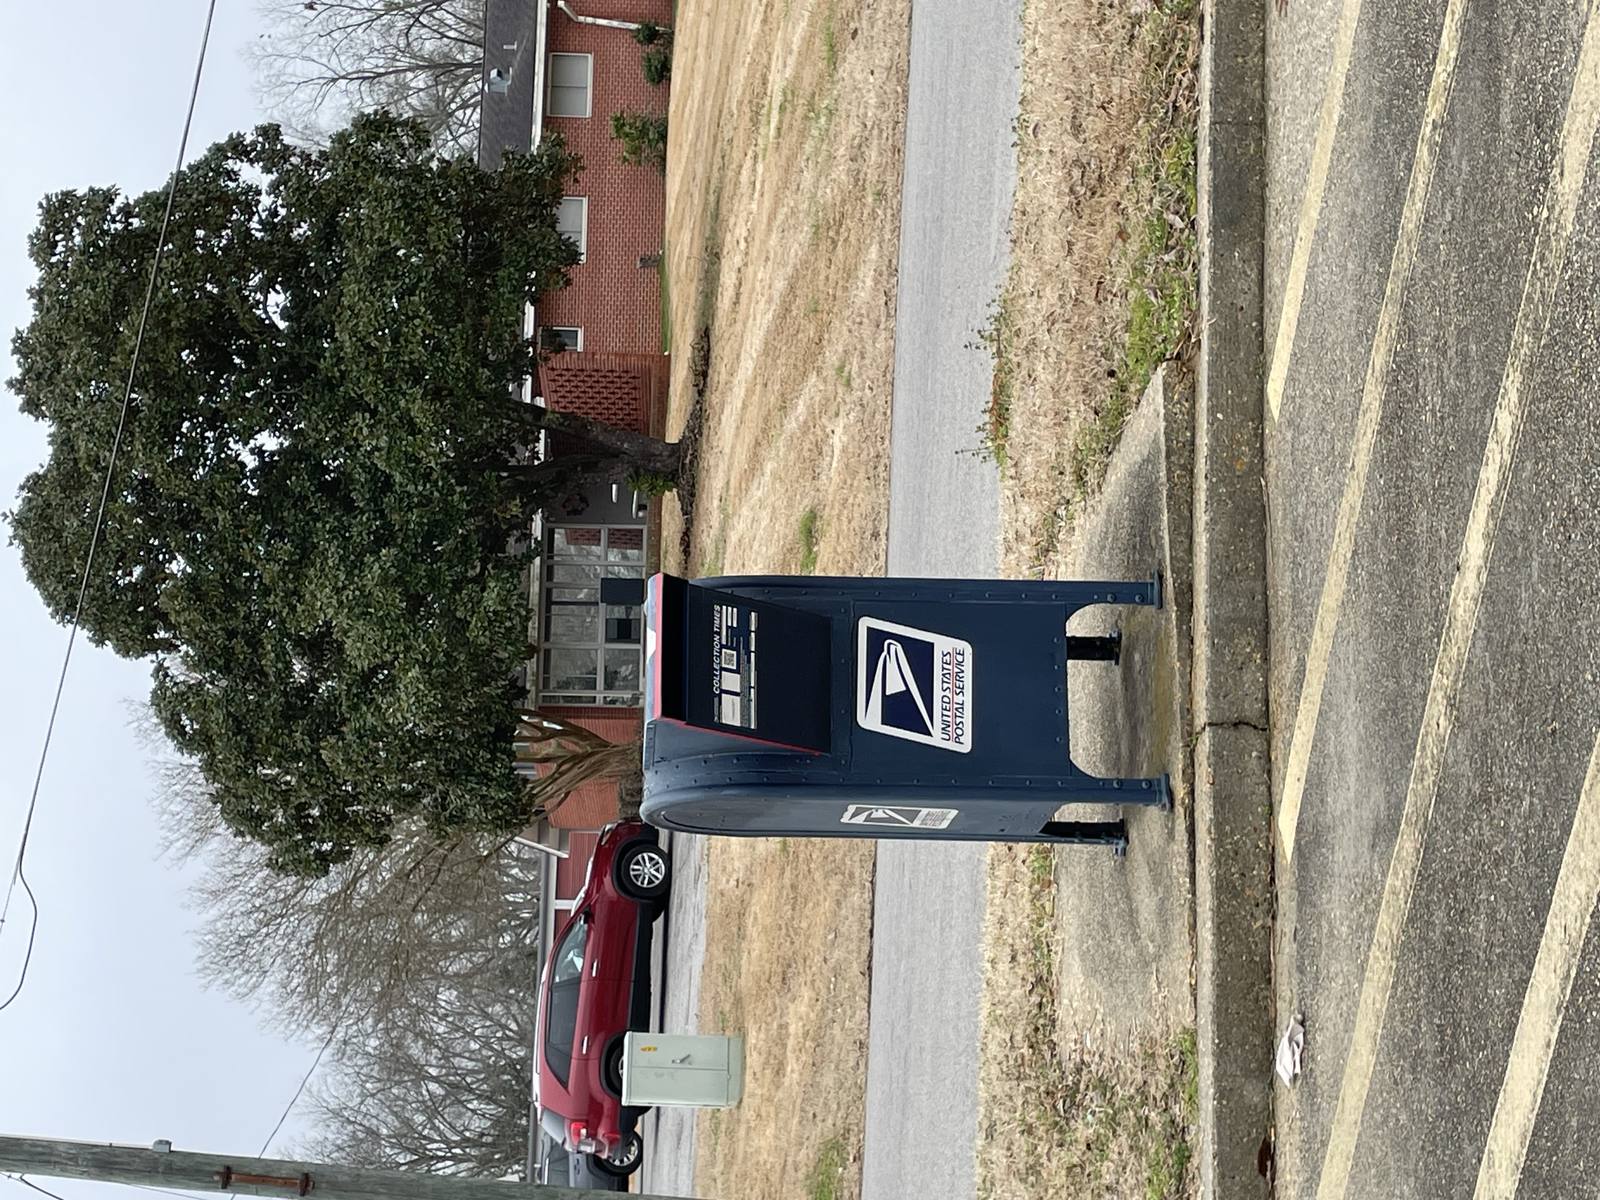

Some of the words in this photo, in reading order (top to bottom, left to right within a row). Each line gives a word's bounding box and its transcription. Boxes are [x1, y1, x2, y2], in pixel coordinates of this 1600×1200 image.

[713, 604, 721, 632] TIMES
[941, 650, 952, 693] STATES
[954, 648, 965, 697] SERVICE
[941, 695, 951, 742] UNITED
[954, 700, 965, 745] POSTAL
